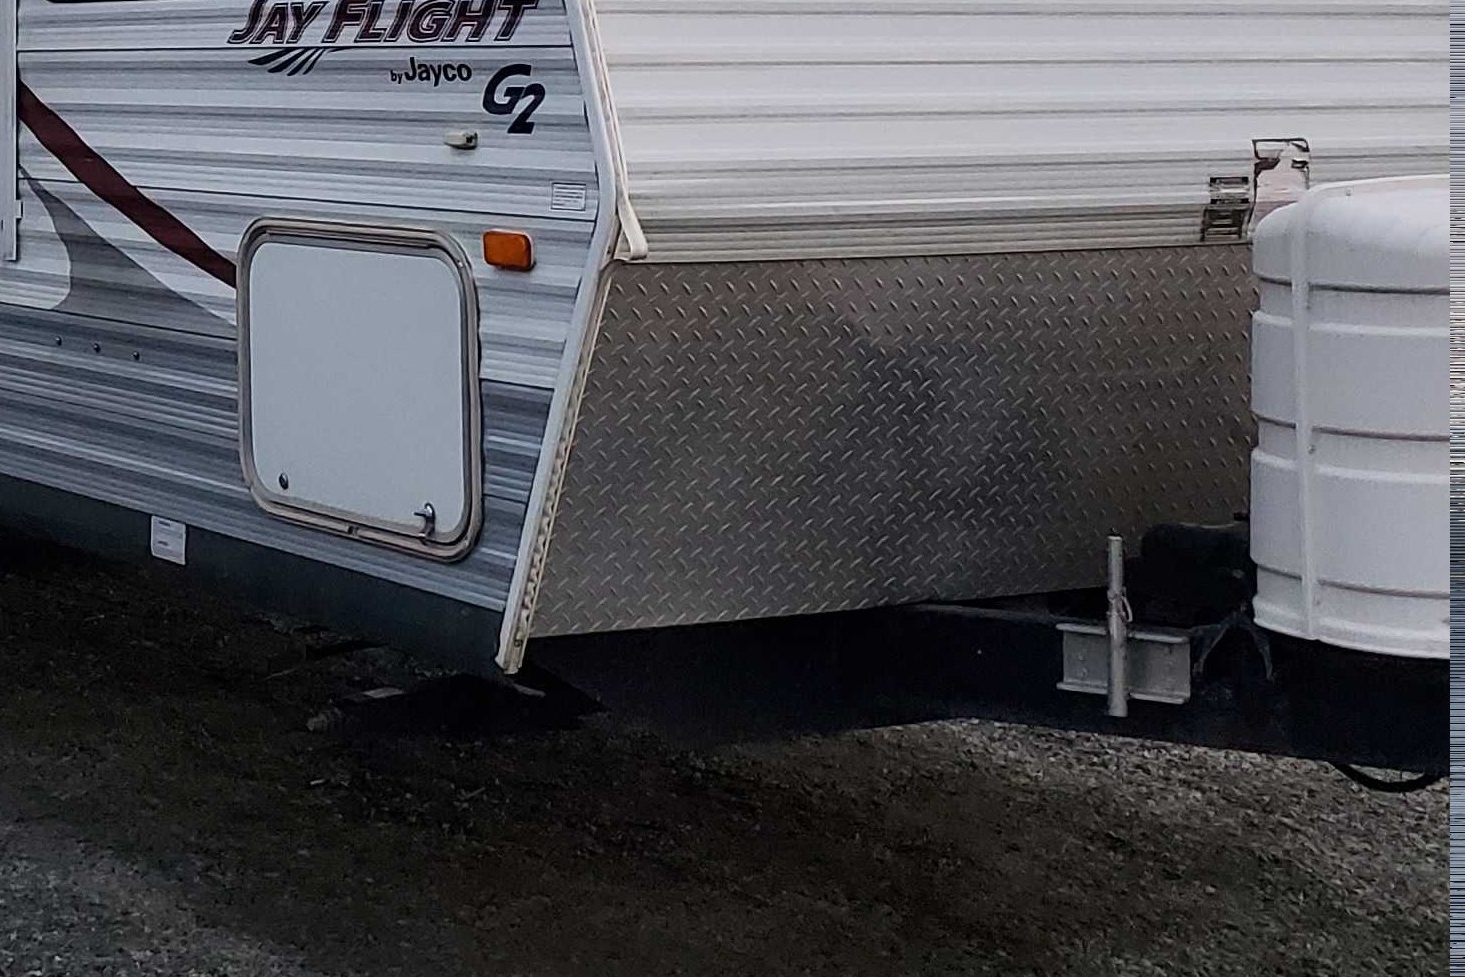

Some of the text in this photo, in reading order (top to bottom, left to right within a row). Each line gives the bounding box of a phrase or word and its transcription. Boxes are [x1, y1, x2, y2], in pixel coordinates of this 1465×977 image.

[390, 56, 472, 87] by Jayco
[482, 63, 546, 134] G2
